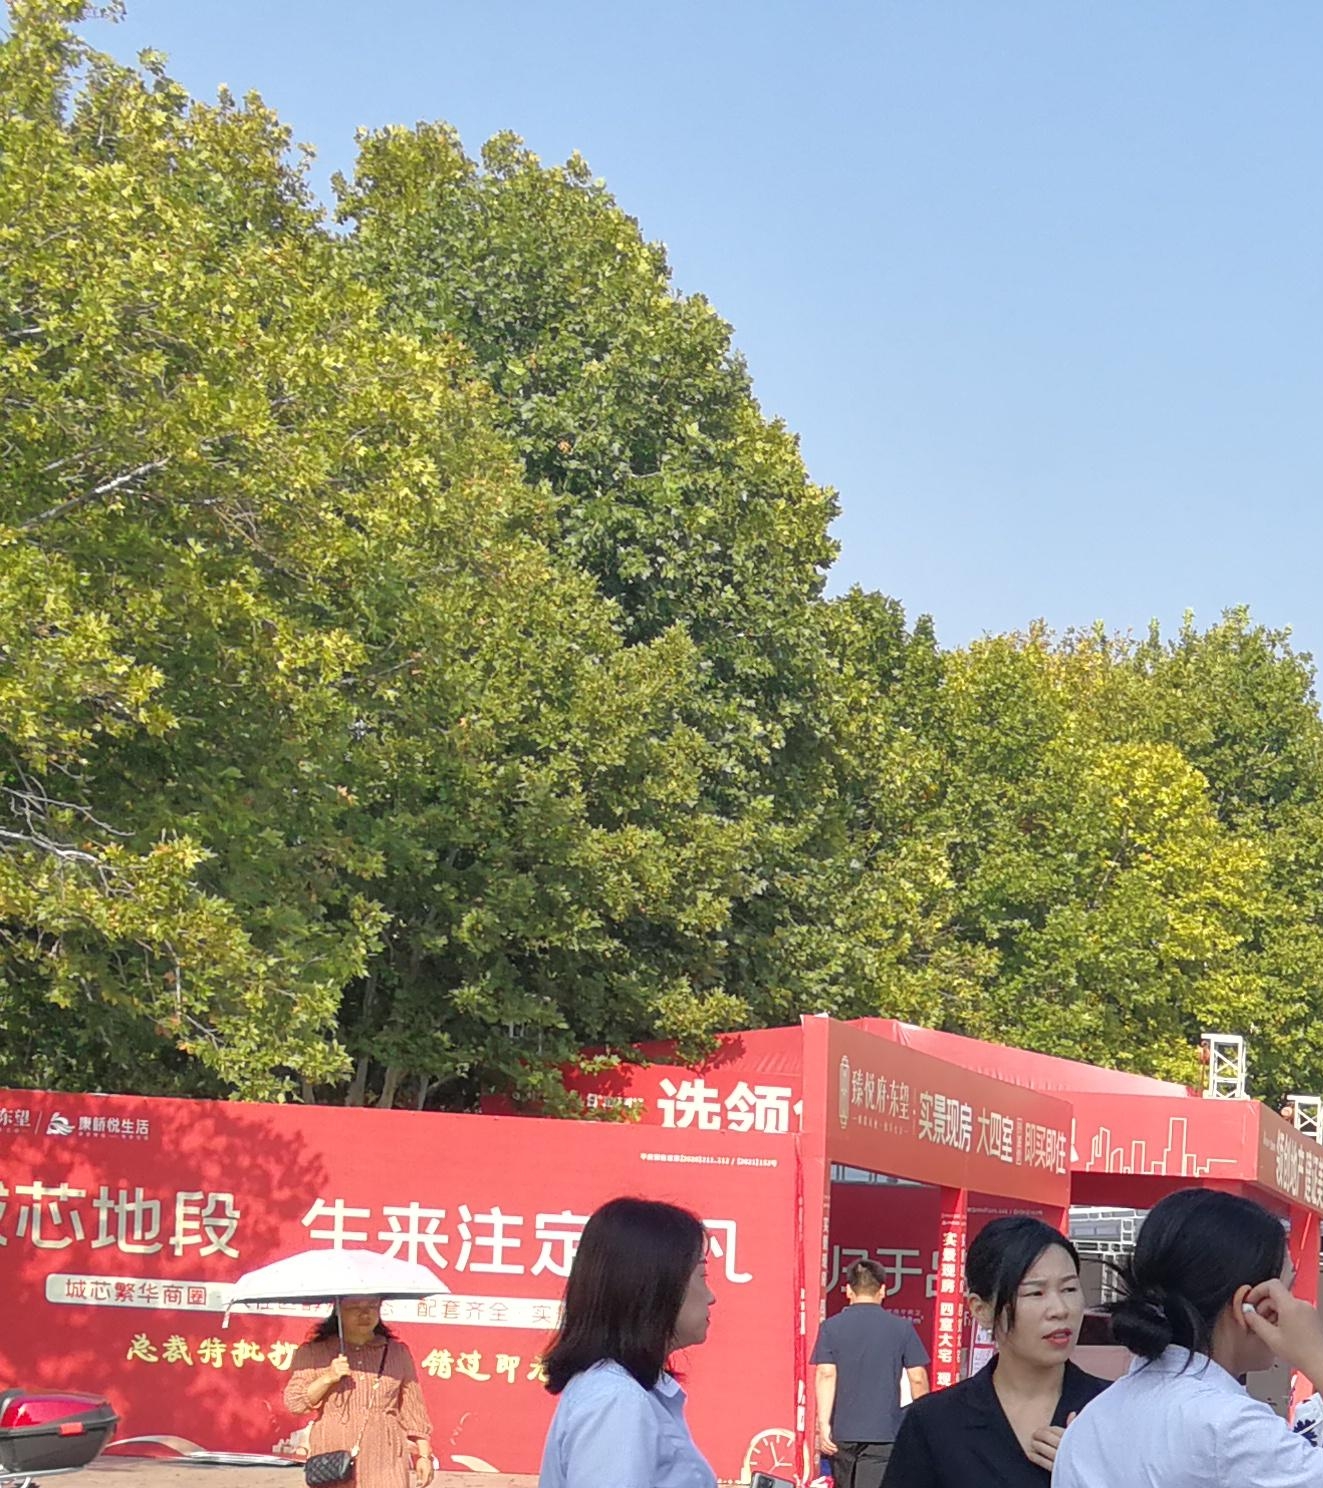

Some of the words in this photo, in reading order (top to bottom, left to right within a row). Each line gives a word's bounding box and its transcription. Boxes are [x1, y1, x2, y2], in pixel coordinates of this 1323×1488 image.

[918, 1091, 973, 1154] 实景现房
[976, 1106, 1015, 1164] 大四室
[1024, 1121, 1068, 1176] 即买即住
[64, 1279, 208, 1306] 城芯繁华商圈
[937, 1231, 958, 1293] 实景现房
[937, 1301, 955, 1363] 四室大宅
